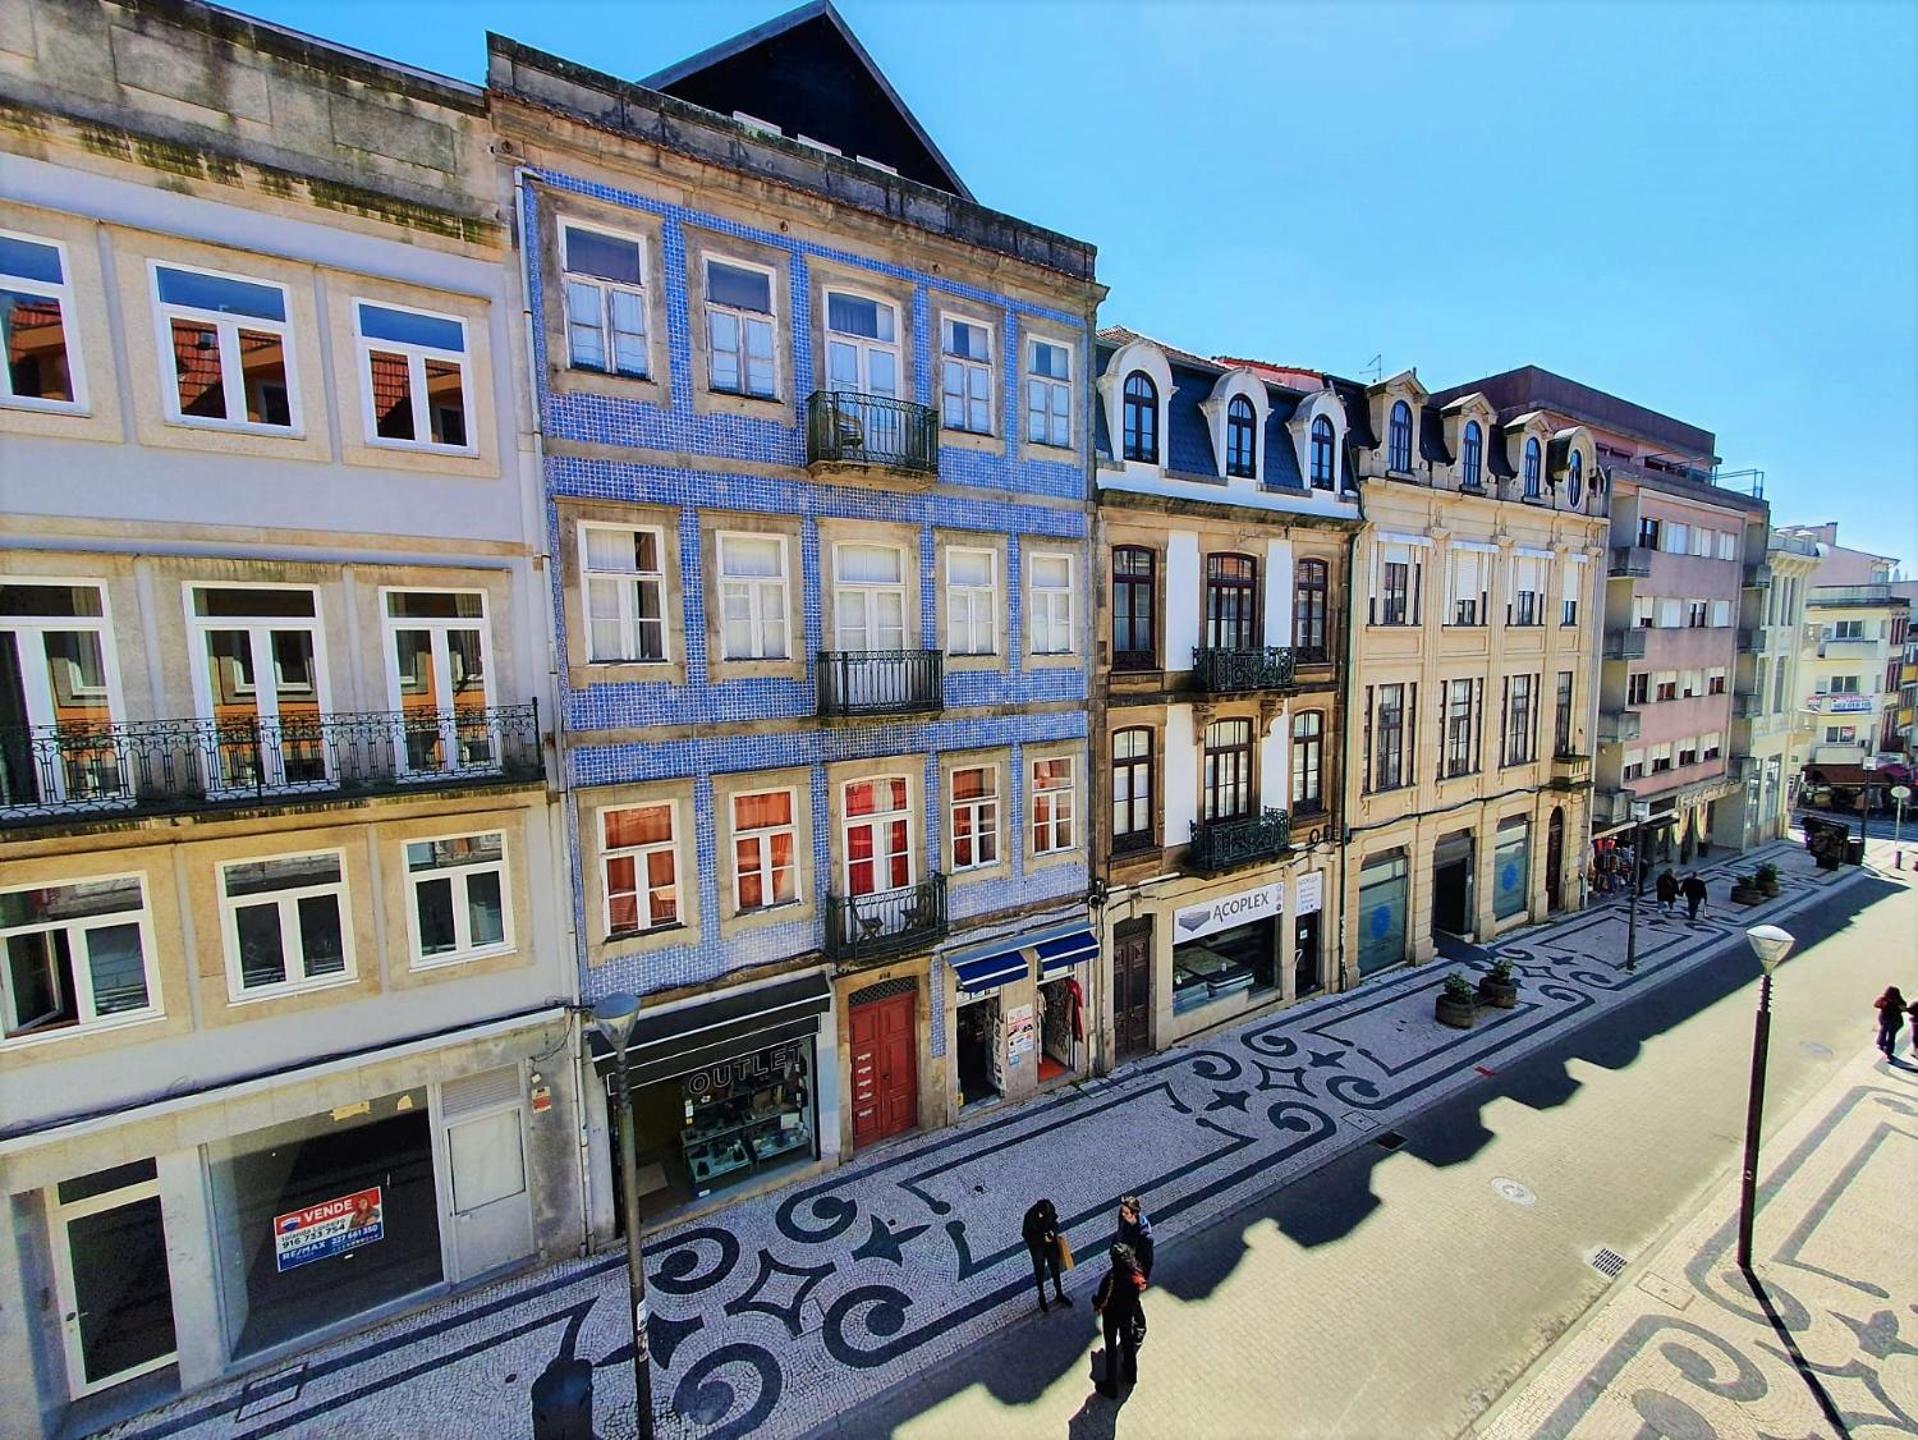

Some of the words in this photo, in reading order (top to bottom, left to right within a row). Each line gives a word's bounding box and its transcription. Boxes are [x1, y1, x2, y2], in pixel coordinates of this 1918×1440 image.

[1213, 891, 1269, 922] ACOPLEX
[689, 1042, 804, 1095] OUTLET
[304, 1199, 353, 1222] VENDE
[282, 1238, 301, 1249] 916
[282, 1241, 326, 1260] RE/MAX
